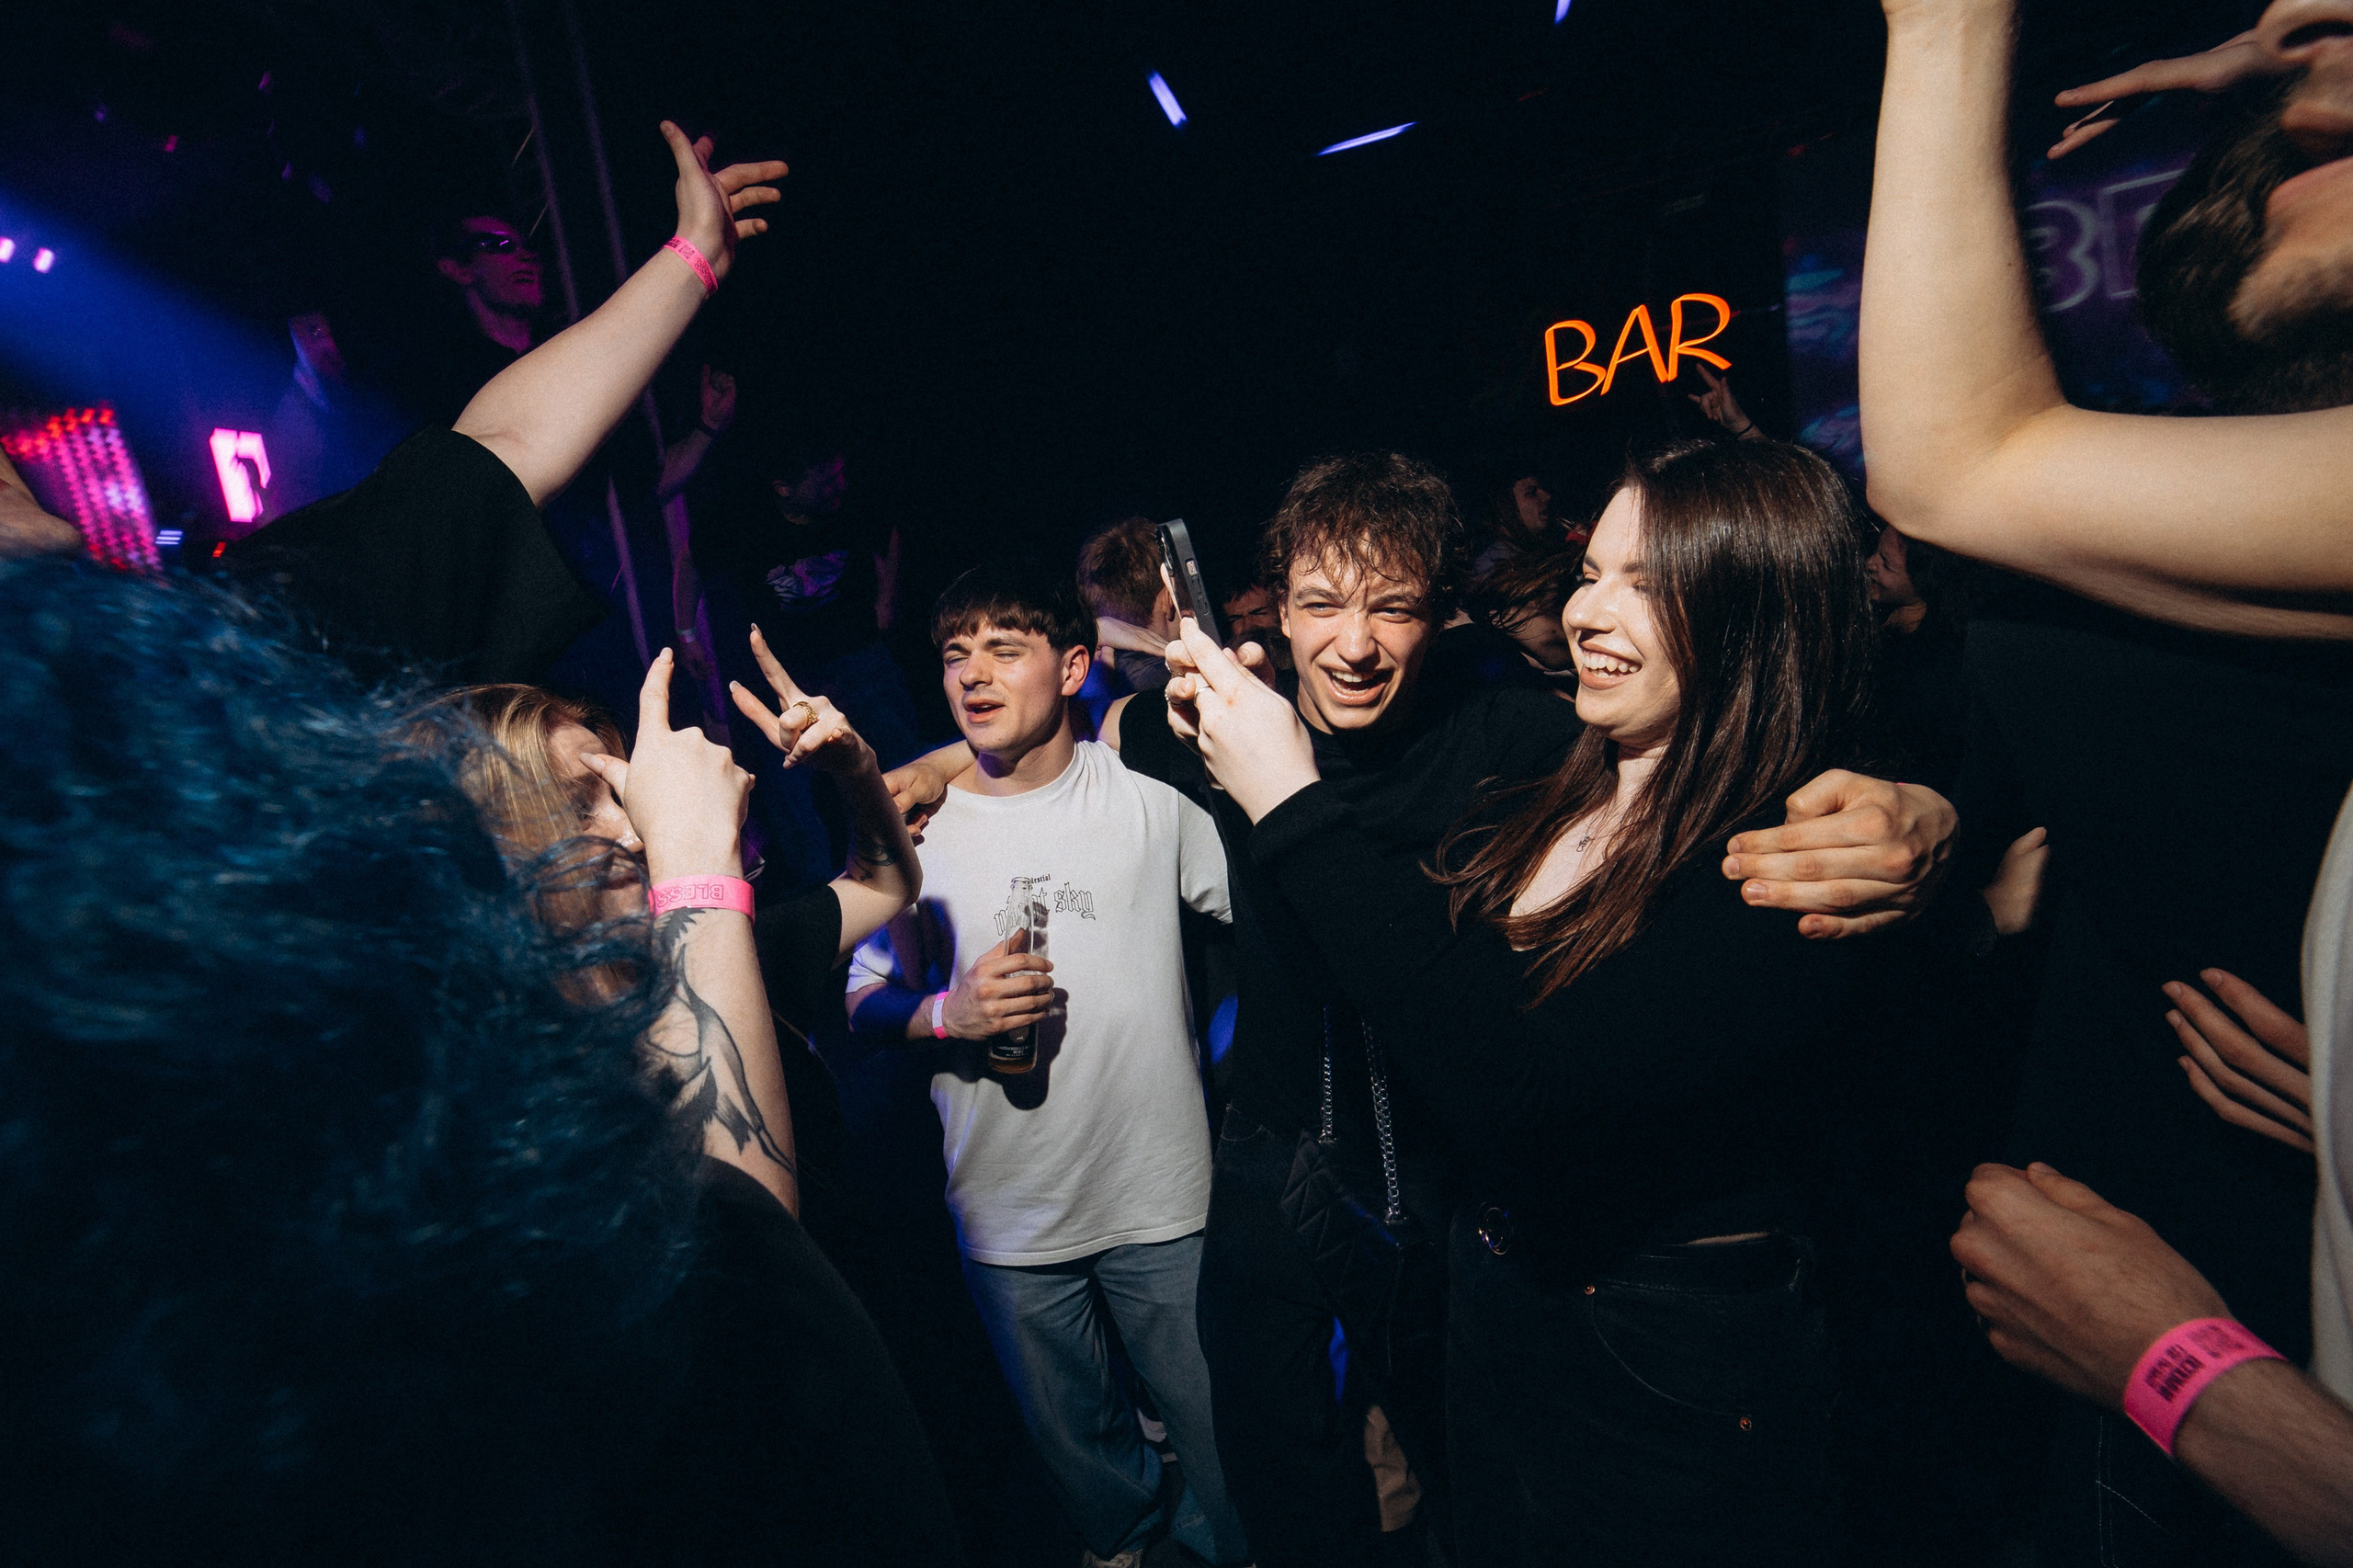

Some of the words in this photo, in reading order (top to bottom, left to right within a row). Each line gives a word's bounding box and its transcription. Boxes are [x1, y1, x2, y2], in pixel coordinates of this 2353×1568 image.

[1545, 292, 1733, 406] BAR
[656, 883, 724, 907] BLESS
[1052, 881, 1096, 920] sky
